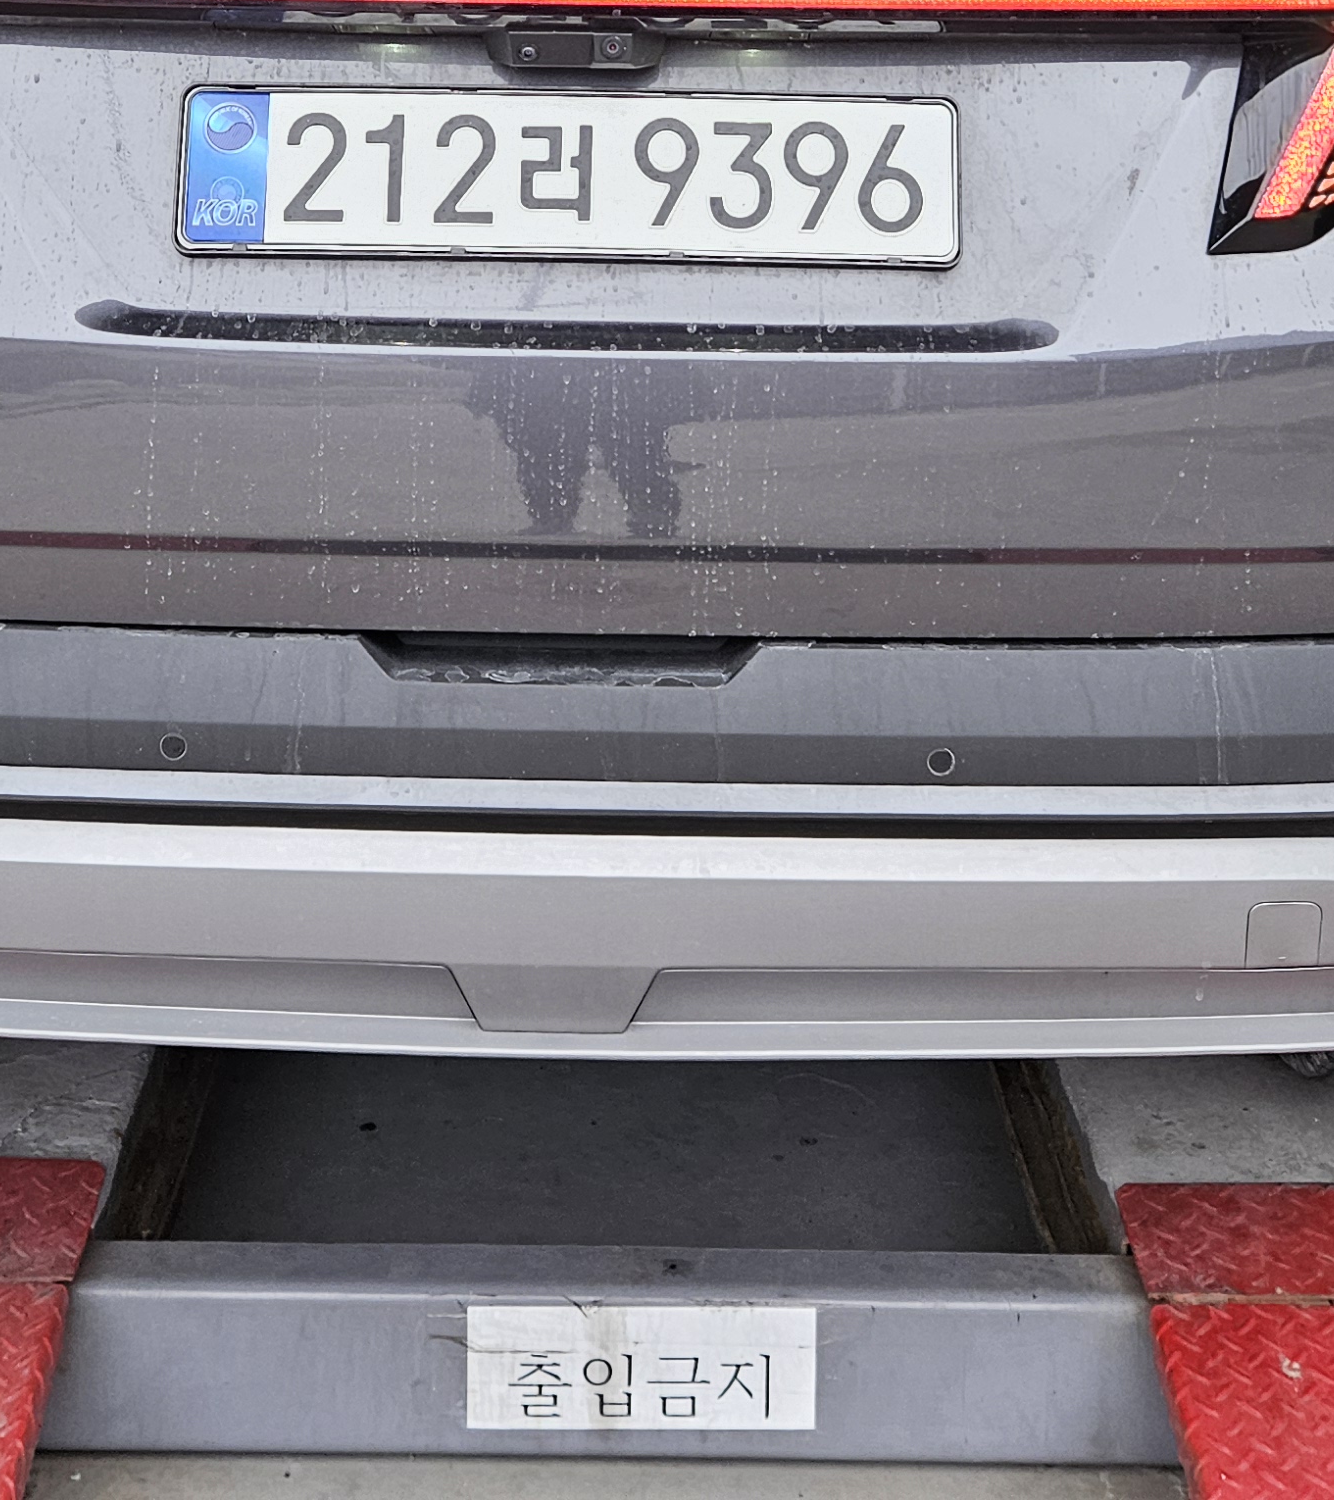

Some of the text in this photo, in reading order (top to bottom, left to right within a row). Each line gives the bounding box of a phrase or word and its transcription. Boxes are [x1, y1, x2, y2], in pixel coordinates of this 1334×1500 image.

[282, 112, 924, 233] 212러 9396
[191, 198, 259, 227] KOR
[508, 1353, 772, 1419] 출입금지
